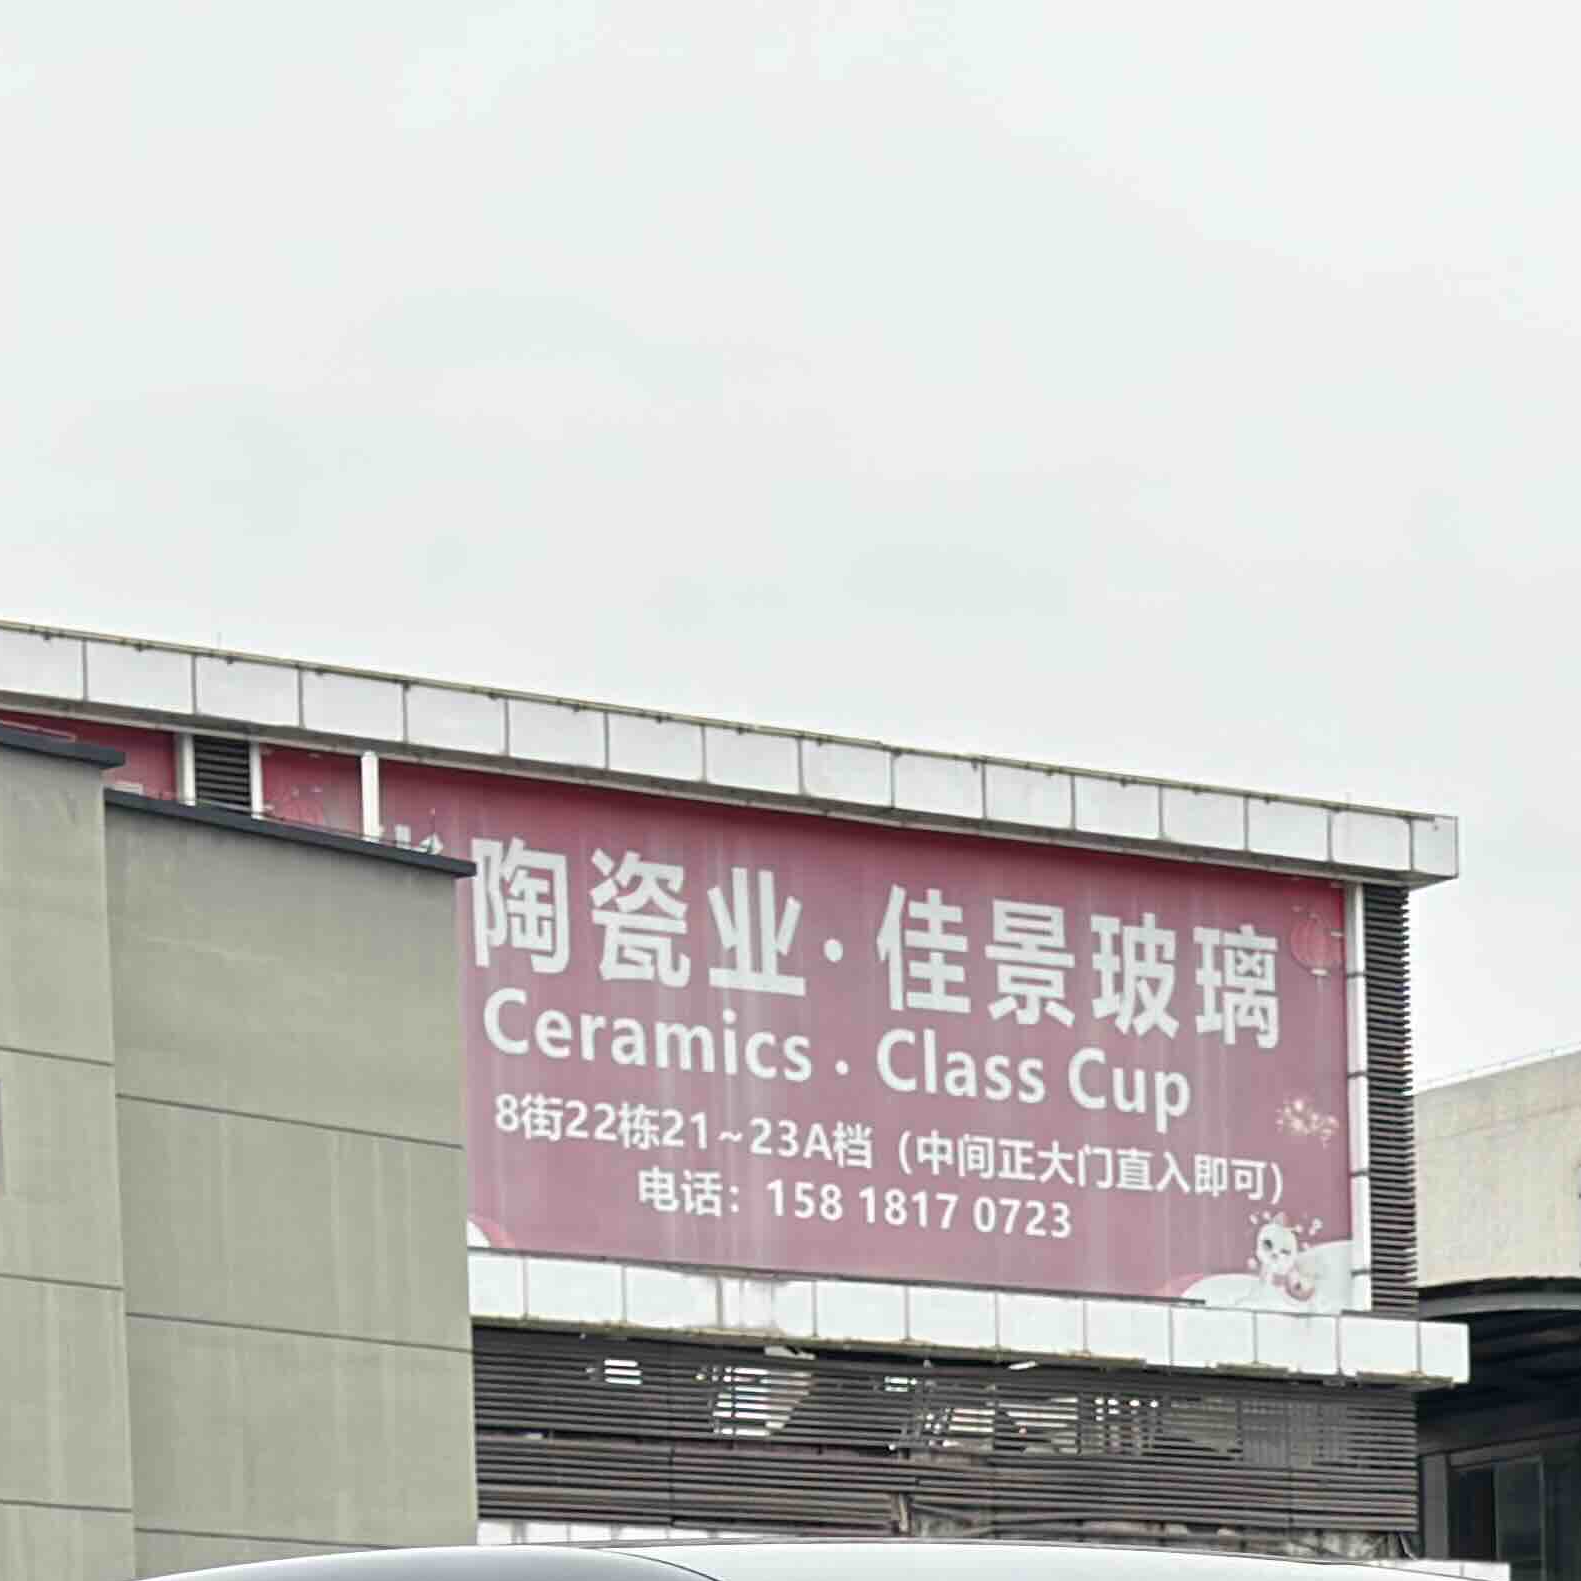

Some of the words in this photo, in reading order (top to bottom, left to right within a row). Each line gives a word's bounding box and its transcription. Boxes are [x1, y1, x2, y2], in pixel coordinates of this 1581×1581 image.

[395, 824, 1280, 1050] 陶瓷业·佳景玻璃
[483, 988, 813, 1084] Ceramics
[877, 1028, 1045, 1106] Class
[1068, 1046, 1192, 1132] Cup
[860, 1189, 957, 1230] 1817
[974, 1197, 1073, 1238] 0723
